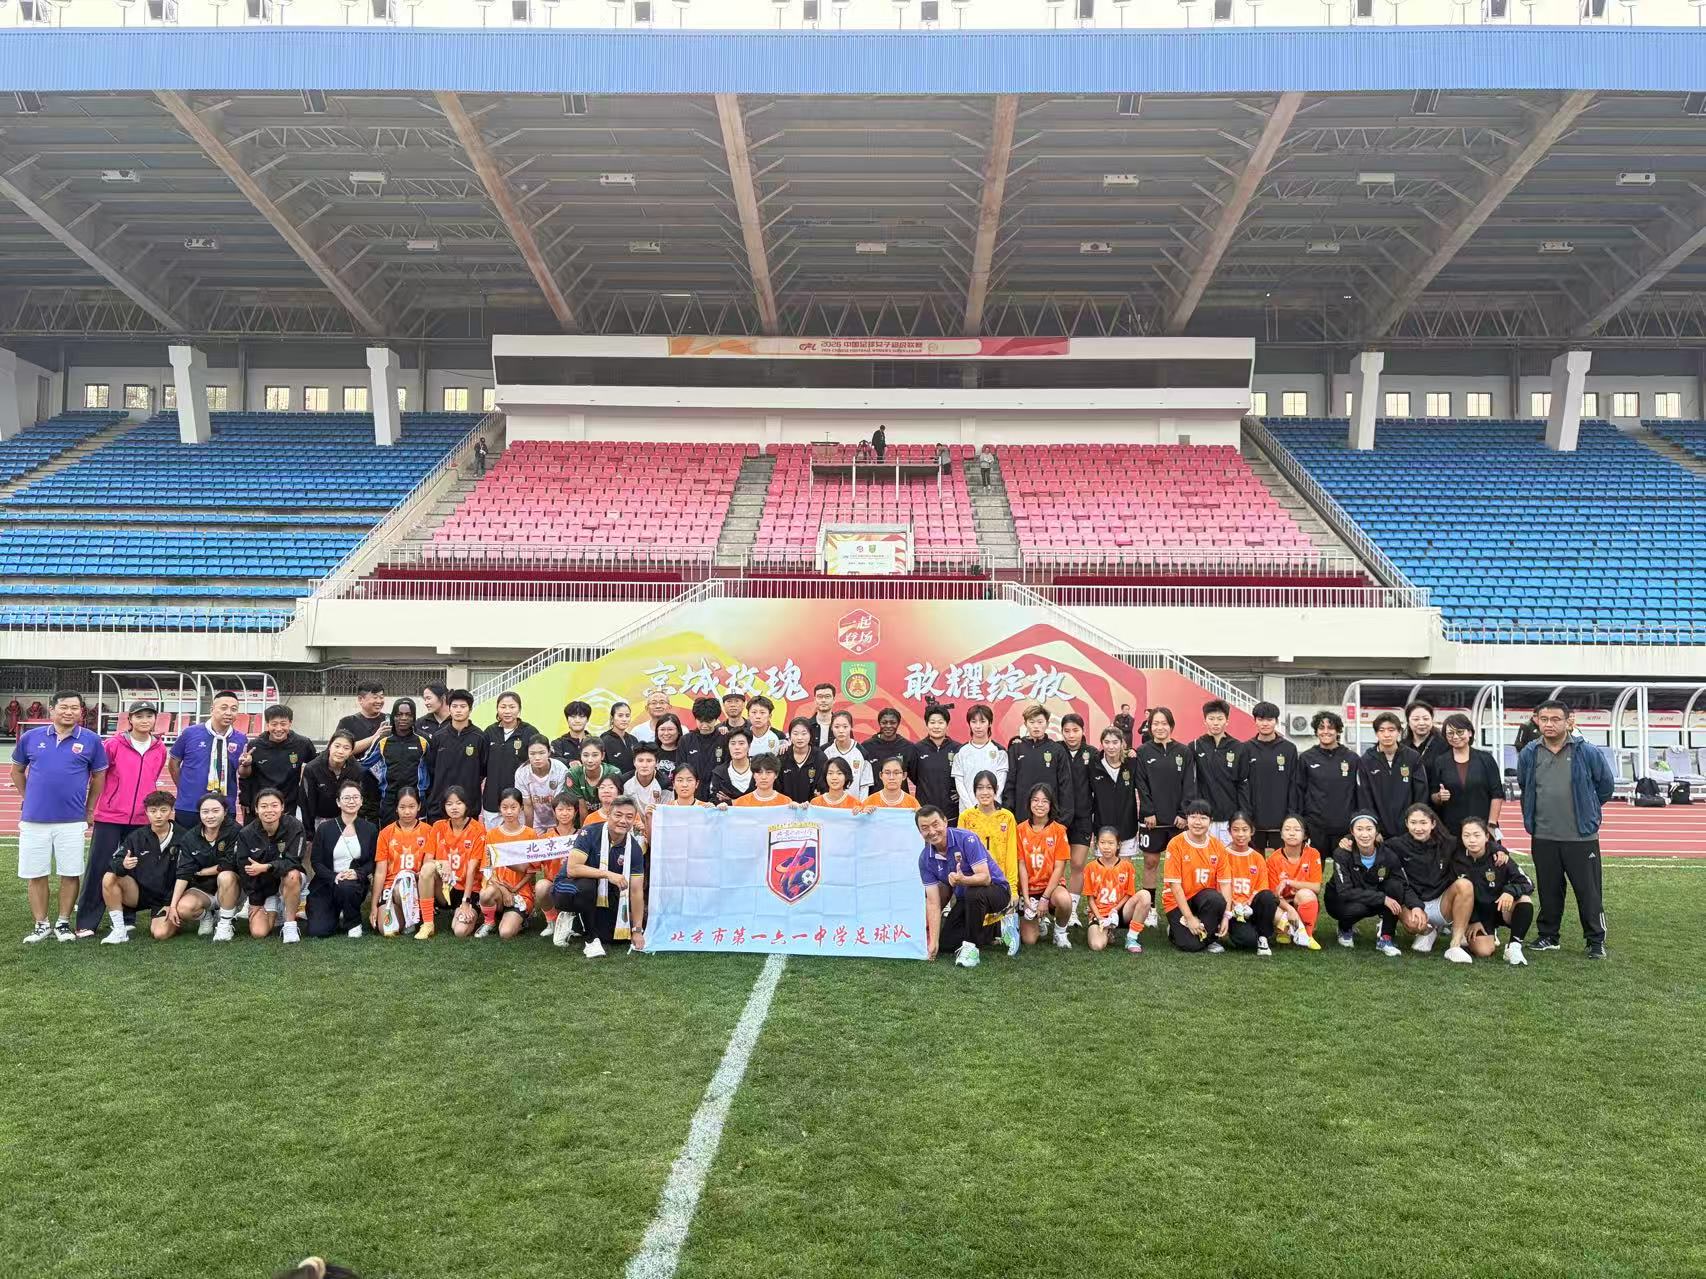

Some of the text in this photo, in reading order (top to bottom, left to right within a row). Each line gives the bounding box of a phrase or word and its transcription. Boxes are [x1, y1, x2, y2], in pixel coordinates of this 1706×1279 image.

[641, 657, 809, 702] 京城玫瑰
[902, 661, 1077, 703] 敢耀绽放
[400, 853, 415, 869] 18
[1030, 853, 1045, 869] 16
[1194, 868, 1210, 884] 15
[1233, 878, 1251, 894] 55
[1100, 888, 1117, 905] 24
[670, 923, 912, 947] 北京市第一六一中学足球队
